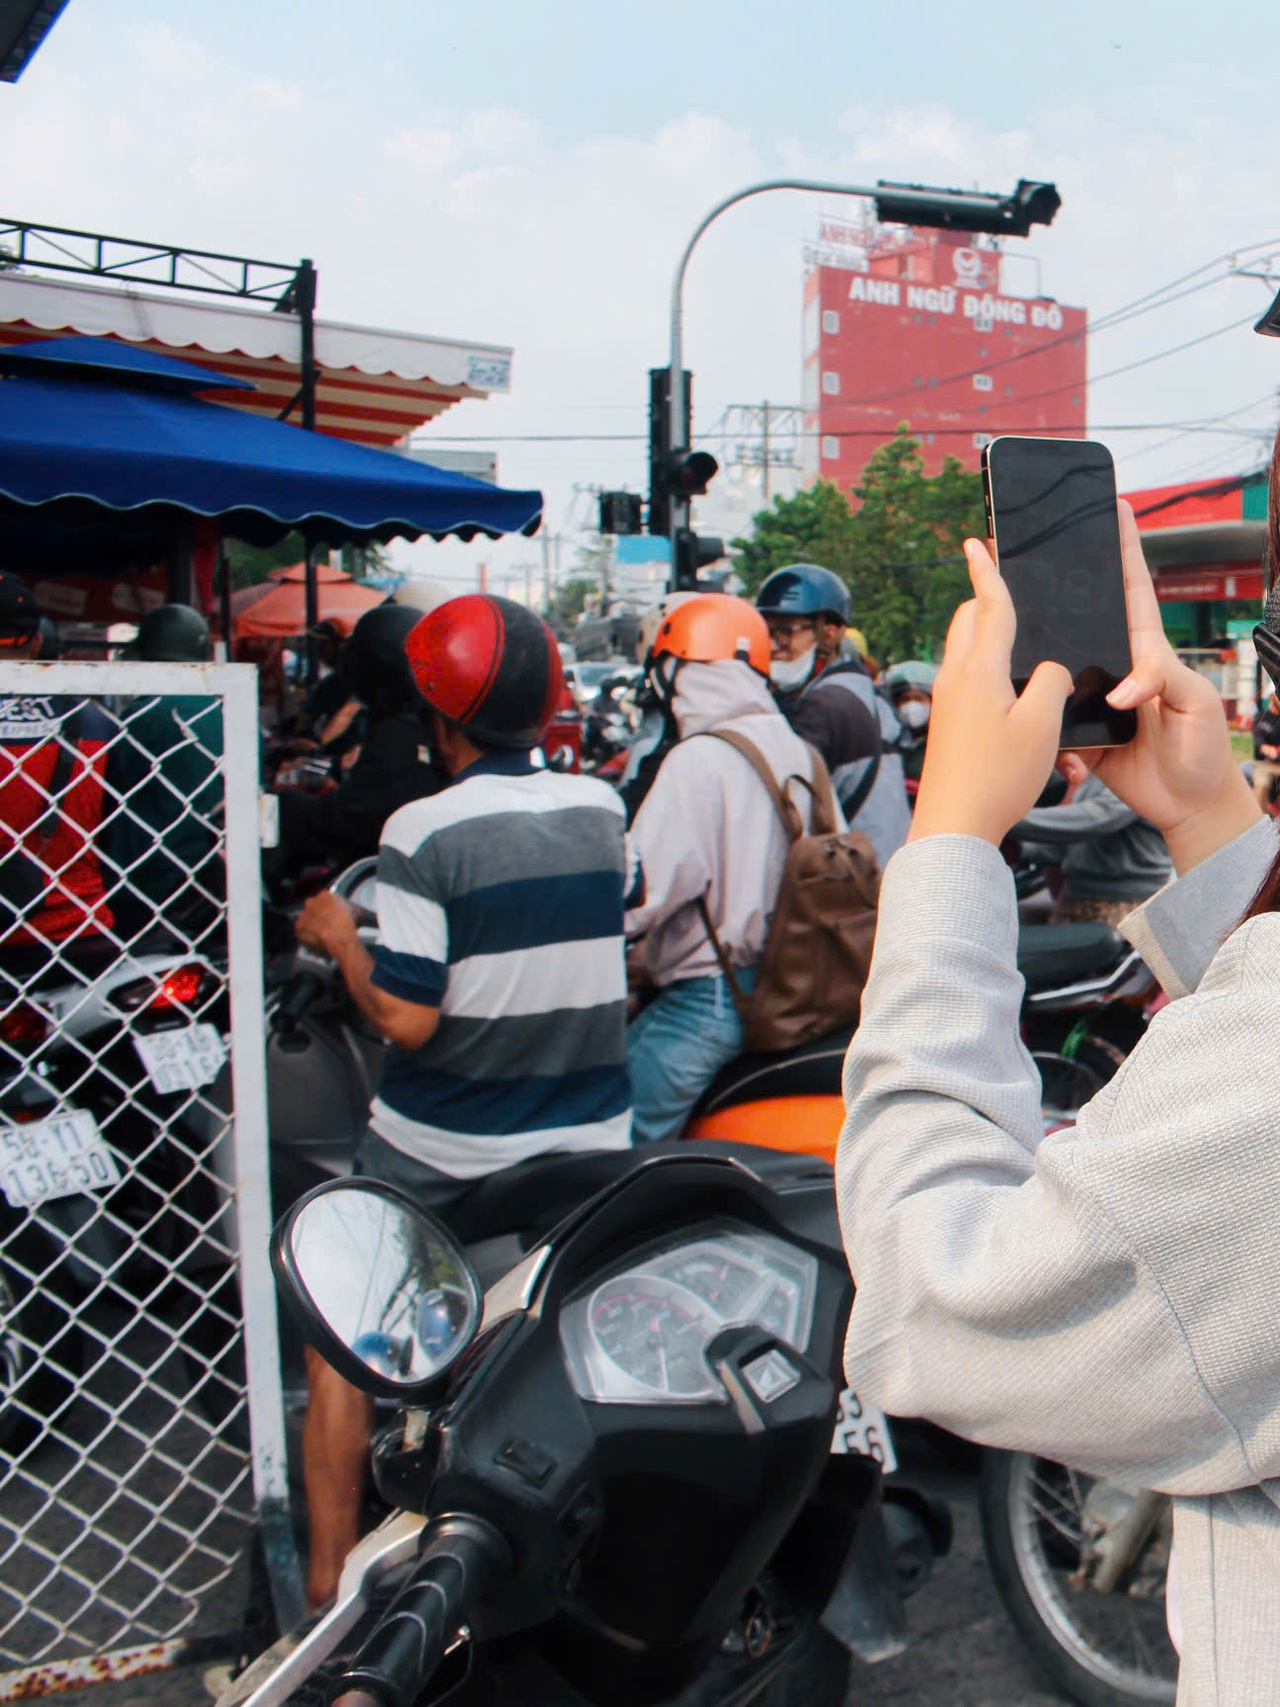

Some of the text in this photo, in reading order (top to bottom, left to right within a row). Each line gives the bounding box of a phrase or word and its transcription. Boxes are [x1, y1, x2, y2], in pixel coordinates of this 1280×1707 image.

[850, 277, 1064, 331] ANH NGỮ ĐÔNG ĐÔ
